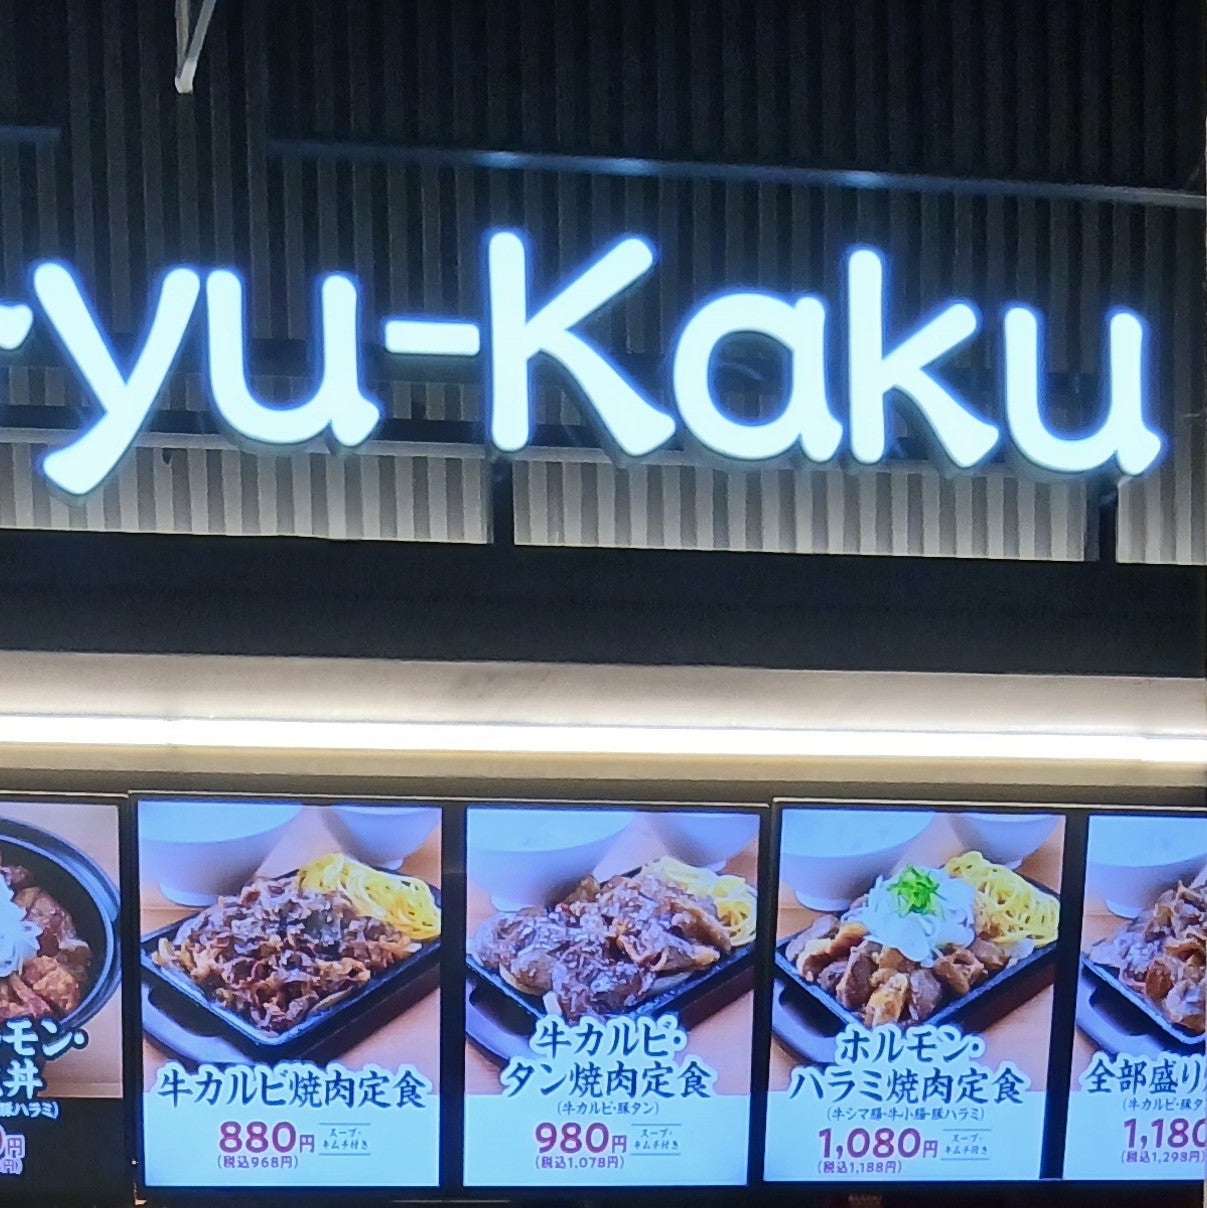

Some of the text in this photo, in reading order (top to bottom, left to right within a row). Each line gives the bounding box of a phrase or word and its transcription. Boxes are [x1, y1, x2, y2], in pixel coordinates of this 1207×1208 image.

[157, 1068, 427, 1109] 牛カルビ焼肉定食
[505, 1060, 712, 1099] タン焼肉定食
[788, 1067, 1027, 1105] ハラミ焼肉定食
[1084, 1057, 1207, 1095] 全部盛り
[219, 1121, 315, 1153] 880円
[535, 1122, 628, 1154] 980円
[818, 1127, 939, 1159] 1,080円
